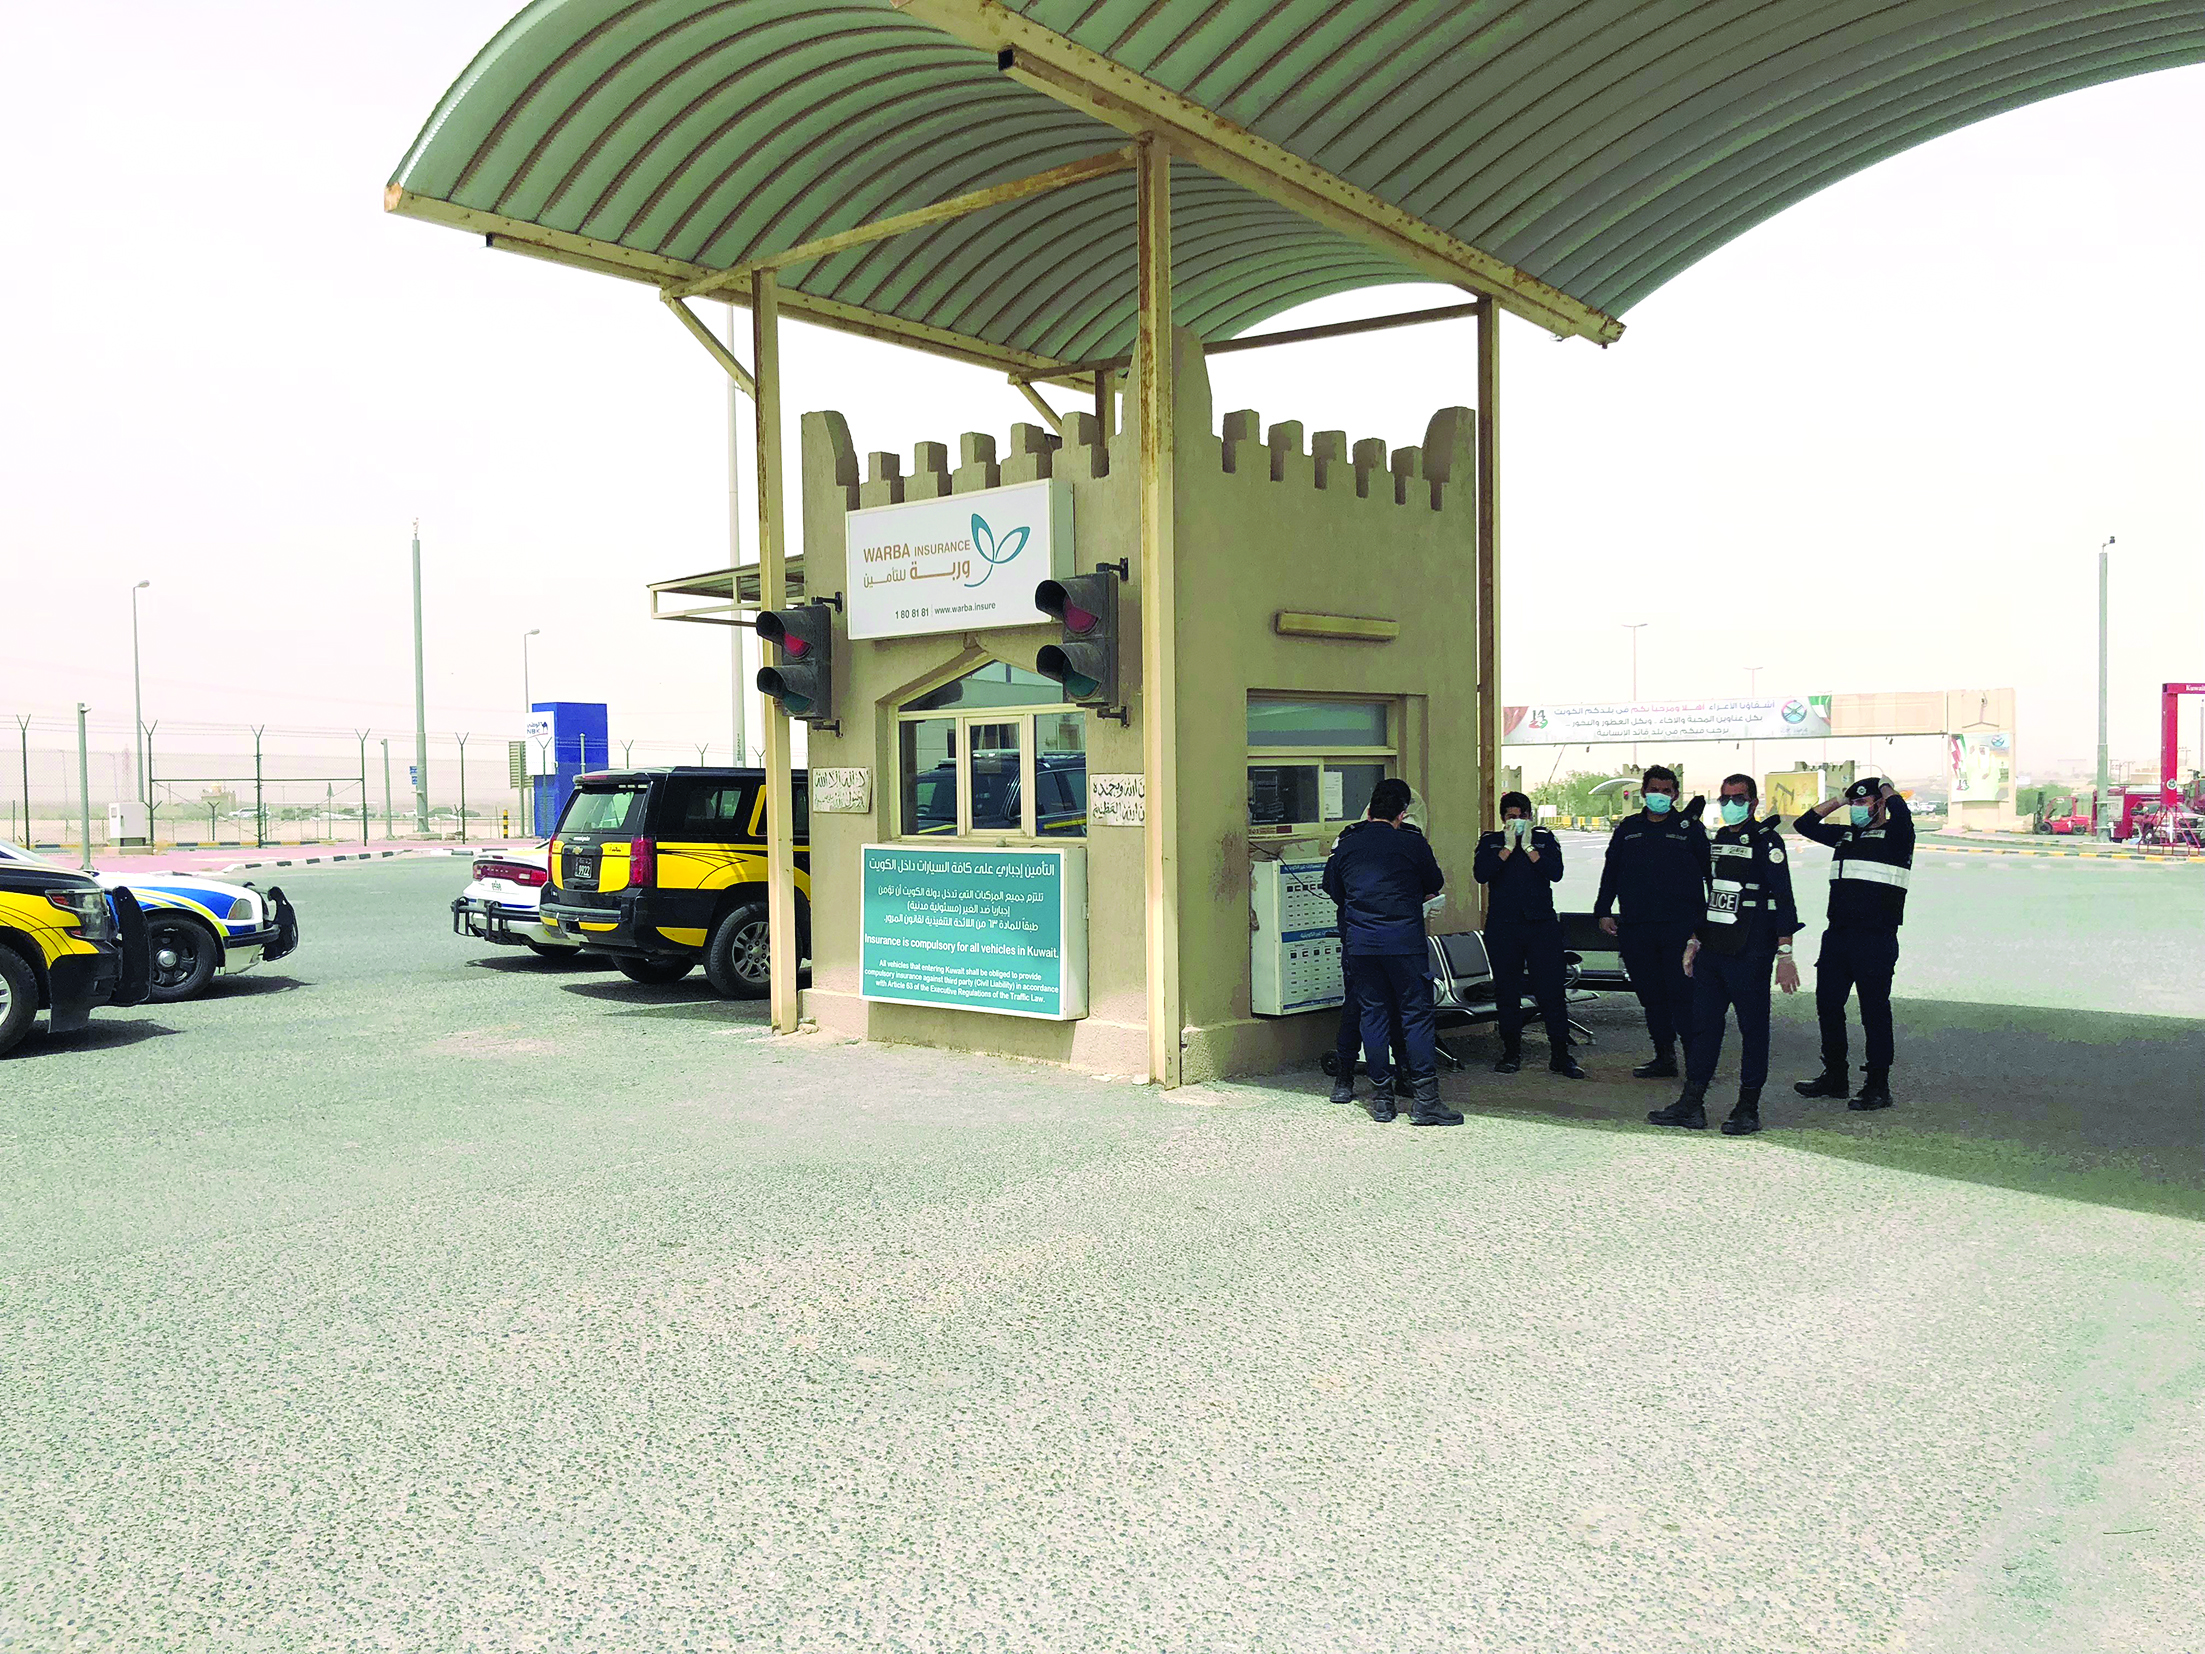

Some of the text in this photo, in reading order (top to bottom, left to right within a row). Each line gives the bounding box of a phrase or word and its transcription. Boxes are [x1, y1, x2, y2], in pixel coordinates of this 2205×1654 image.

[863, 539, 971, 563] WARBA INSURANCE
[863, 559, 970, 589] وربة للتأمين
[934, 602, 996, 616] www.warba.insure
[1554, 707, 1584, 716] الكويت
[869, 858, 1055, 878] التأمين إجباري على كافة السيارات داخل الكويت
[878, 884, 1044, 904] تلتزم جميع المركبات التي تدخل دولة الكويت أن تؤمن
[1710, 892, 1735, 910] LICE
[962, 904, 979, 915] الغير
[980, 904, 991, 914] ضد
[903, 914, 925, 925] لقانون
[925, 916, 952, 927] التنفيذية
[953, 917, 974, 928] اللائحة
[975, 919, 987, 930] من
[988, 919, 998, 929] ٦٣
[999, 920, 1021, 931] للمادة
[864, 933, 1059, 959] Insurance is compulsory for all vehicles in Kuwait.
[879, 959, 1042, 981] All vehicles that entering Kuwait shall be obliged to provide
[864, 969, 1059, 993] compulsory insurance against third party (Civil Liability) in accordance
[875, 979, 1046, 1003] with Article 63 of the Executive Regulations of the Traffic Law.
